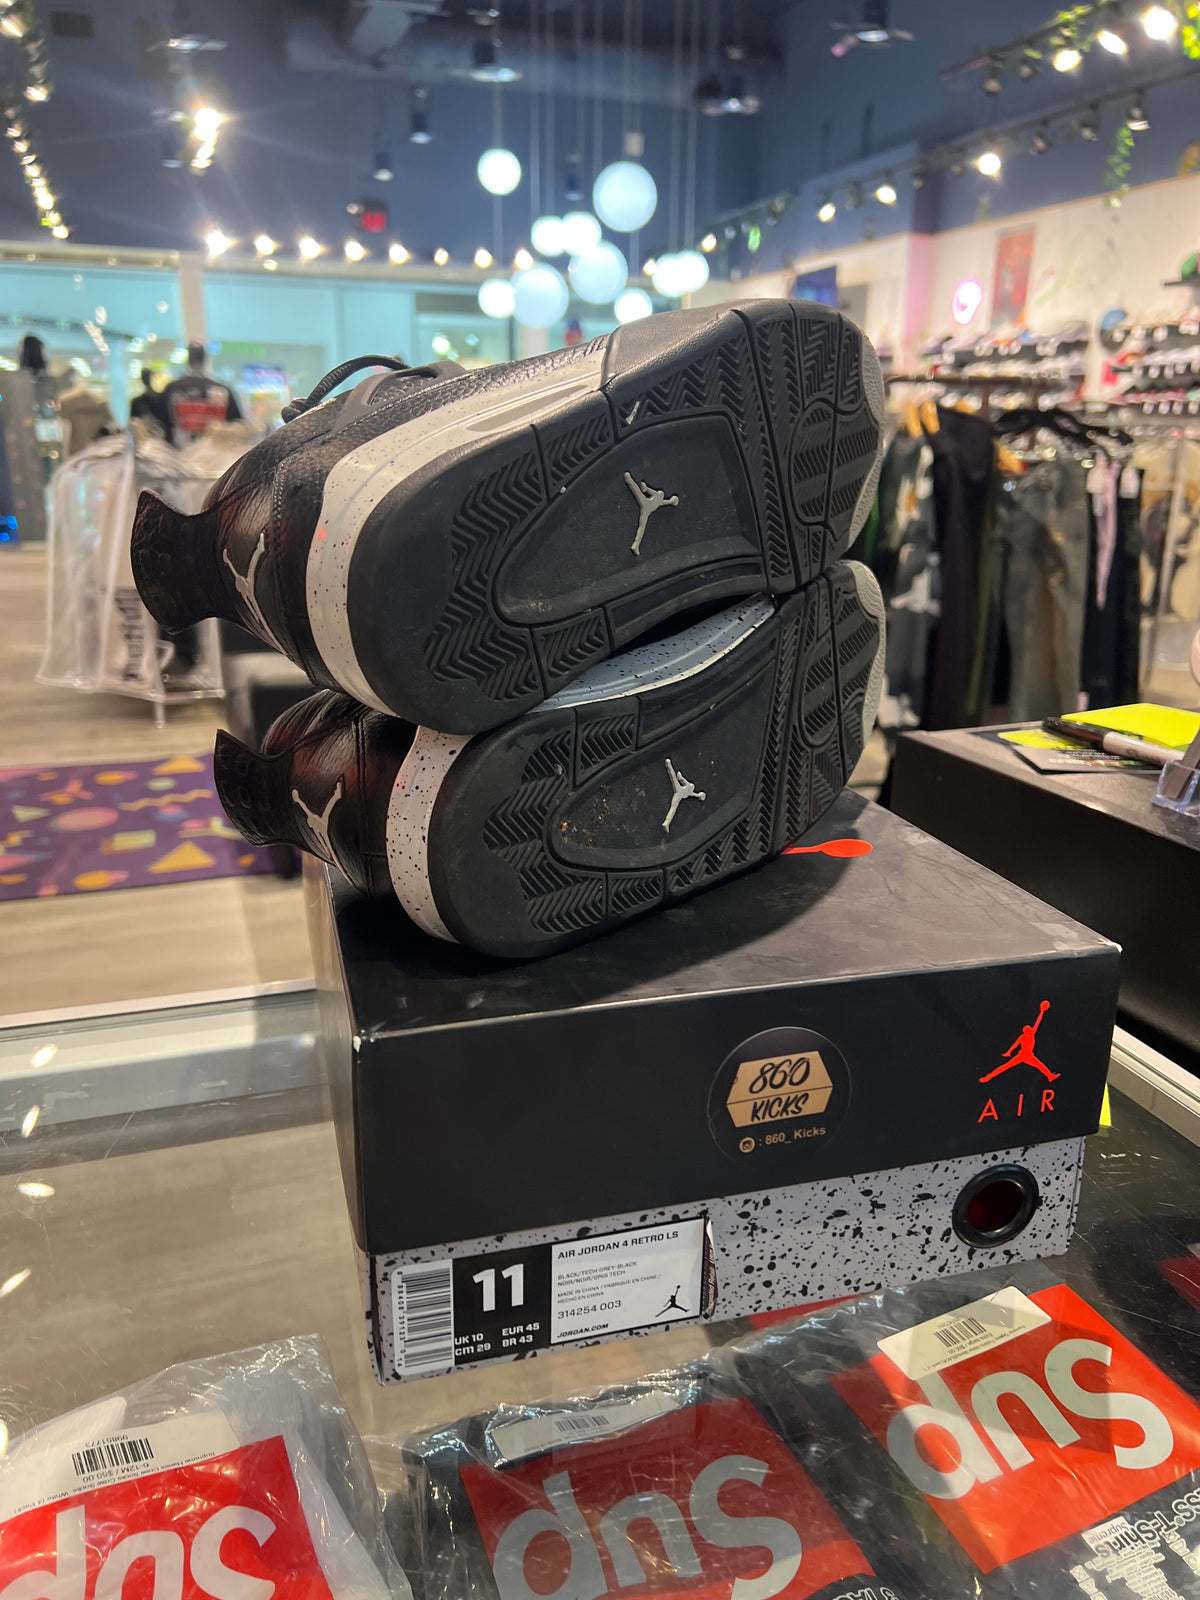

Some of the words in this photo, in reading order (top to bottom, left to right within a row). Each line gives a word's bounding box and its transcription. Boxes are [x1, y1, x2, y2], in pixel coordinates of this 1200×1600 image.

[749, 1057, 810, 1094] 860
[751, 1093, 809, 1122] KICKS
[978, 1089, 1055, 1123] AIR
[794, 1127, 826, 1139] Kicks
[557, 1249, 576, 1260] AIR
[578, 1241, 620, 1257] JORDAN
[622, 1239, 629, 1248] 4
[631, 1233, 665, 1247] RETRO
[666, 1230, 679, 1240] LS
[472, 1264, 524, 1312] 11
[557, 1304, 597, 1320] 314254
[599, 1299, 622, 1312] 003
[454, 1336, 471, 1346] UK
[471, 1333, 484, 1343] 10
[502, 1326, 524, 1337] EUR
[525, 1322, 540, 1332] 45
[502, 1338, 517, 1348] BR
[518, 1334, 534, 1345] 43
[556, 1322, 609, 1339] JORDAN.COM
[476, 1343, 492, 1353] 29
[887, 1338, 1174, 1499] Sup
[492, 1454, 803, 1600] Sup
[1088, 1521, 1129, 1545] Supreme
[1094, 1511, 1179, 1558] T-Shirts
